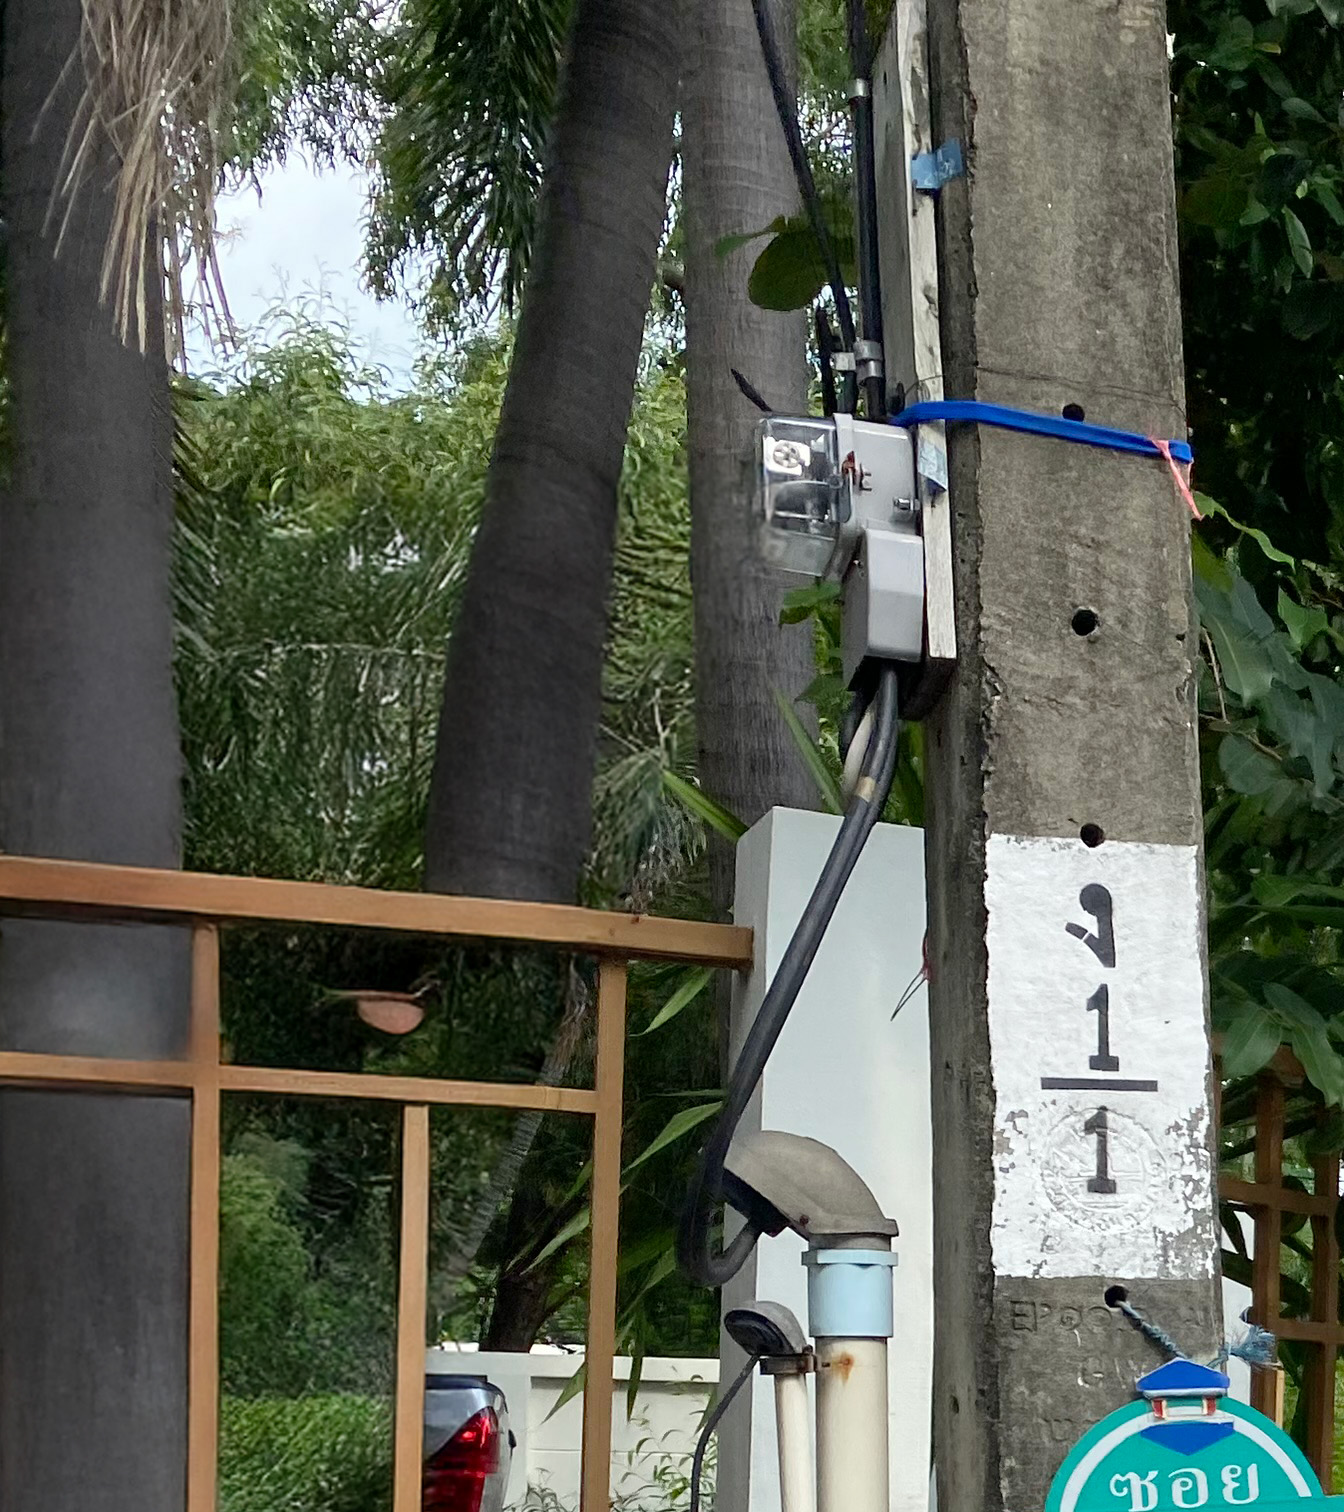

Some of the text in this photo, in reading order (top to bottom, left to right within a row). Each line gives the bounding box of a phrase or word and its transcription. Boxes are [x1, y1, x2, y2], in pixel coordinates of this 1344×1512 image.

[1085, 983, 1120, 1072] 1
[1083, 1105, 1117, 1195] 1
[1109, 1463, 1260, 1512] ซอย
